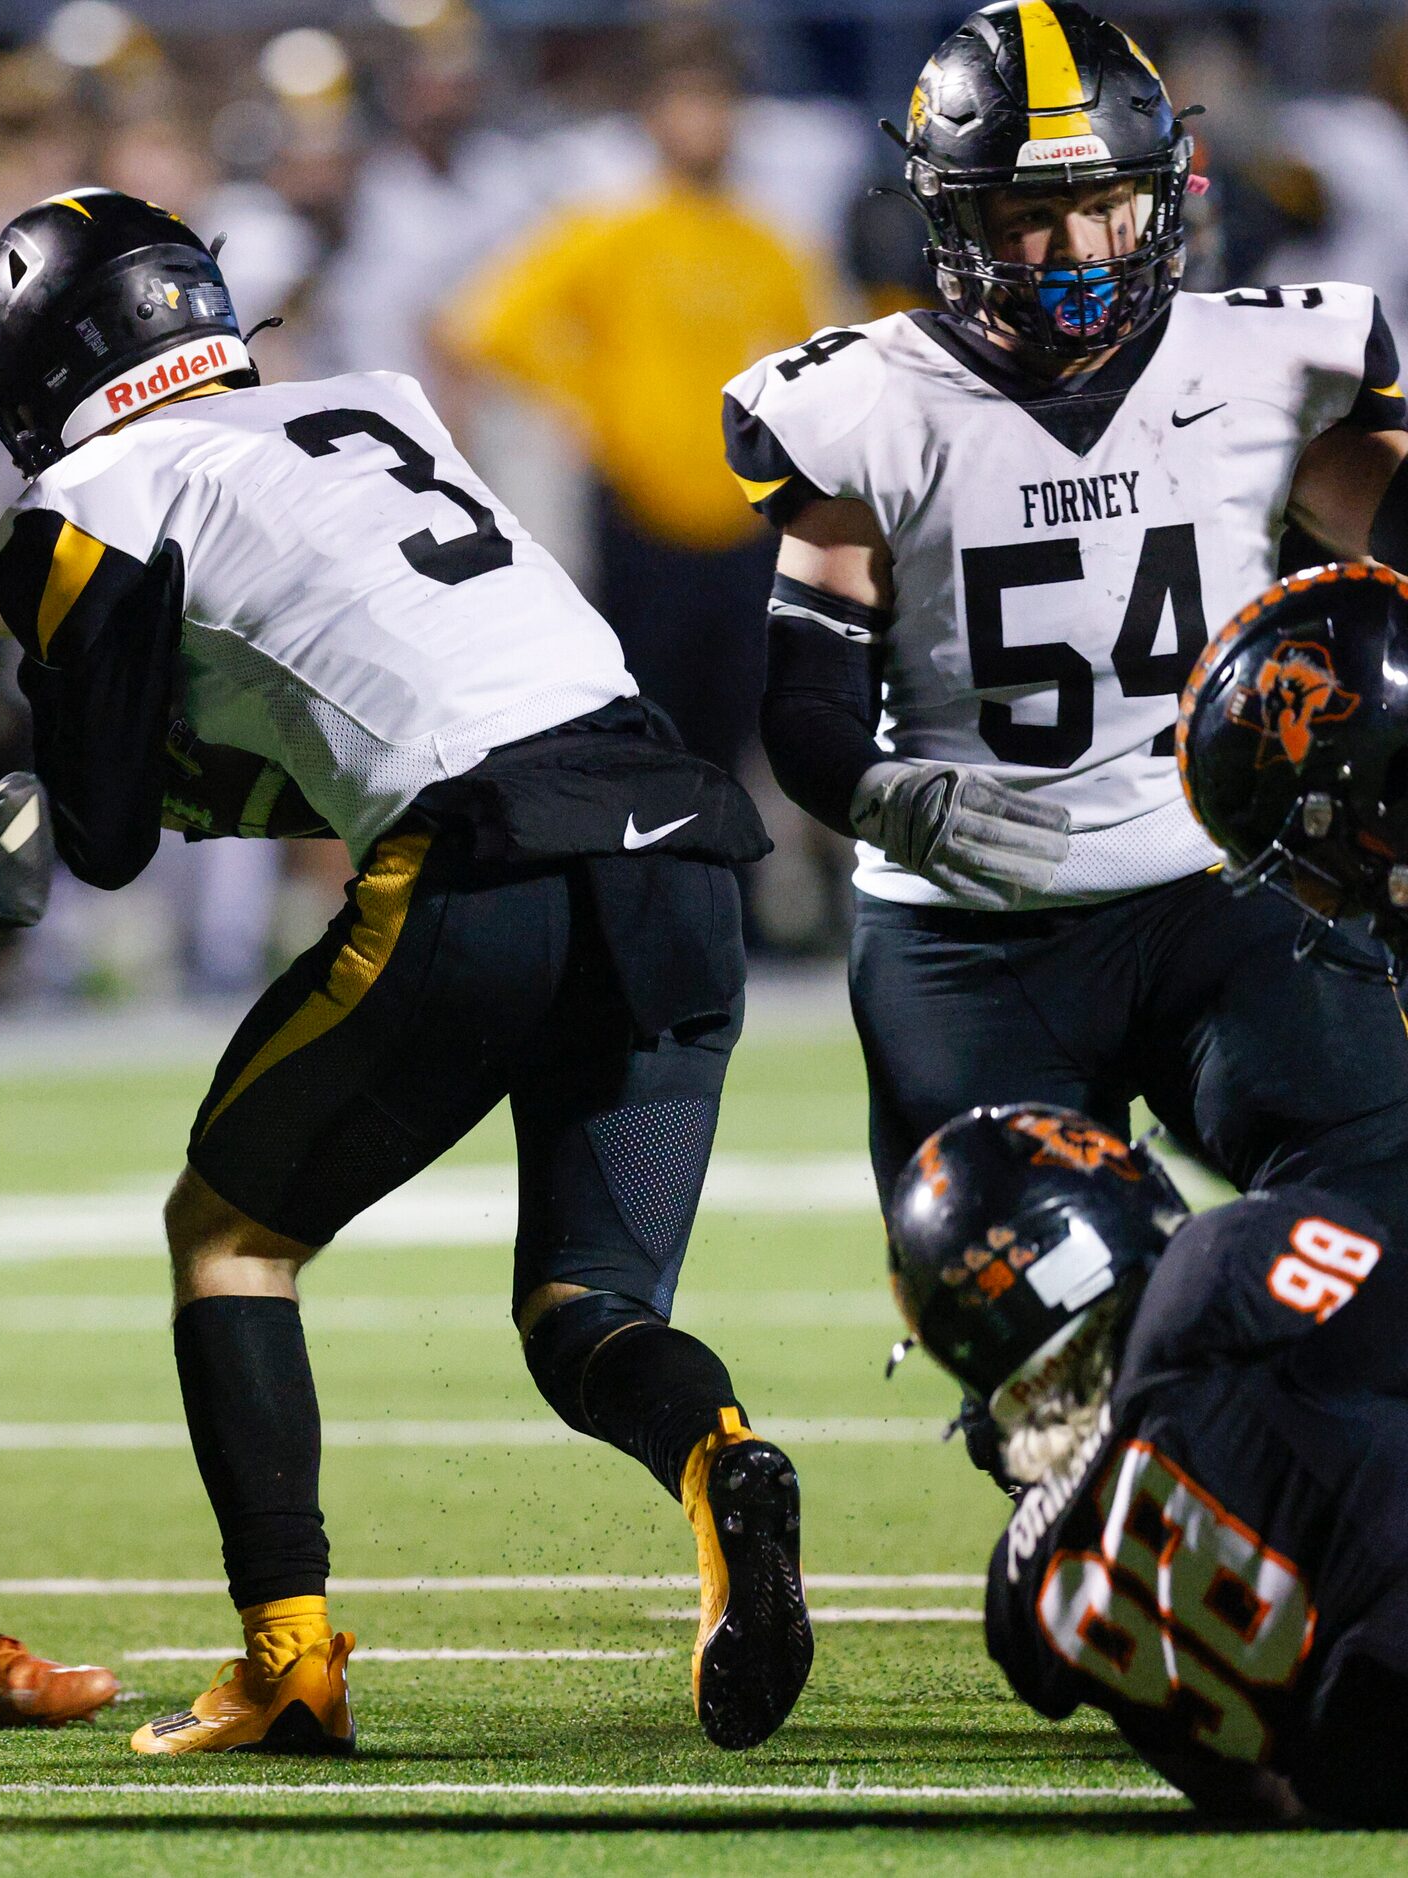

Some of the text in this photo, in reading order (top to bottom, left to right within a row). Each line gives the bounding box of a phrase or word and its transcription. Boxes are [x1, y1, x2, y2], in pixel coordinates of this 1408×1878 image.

[104, 341, 229, 415] Riddell
[283, 408, 515, 586] 3
[1020, 470, 1140, 529] FORNEY
[960, 522, 1210, 769] 54
[1266, 1214, 1384, 1326] 98
[1037, 1438, 1319, 1766] 98
